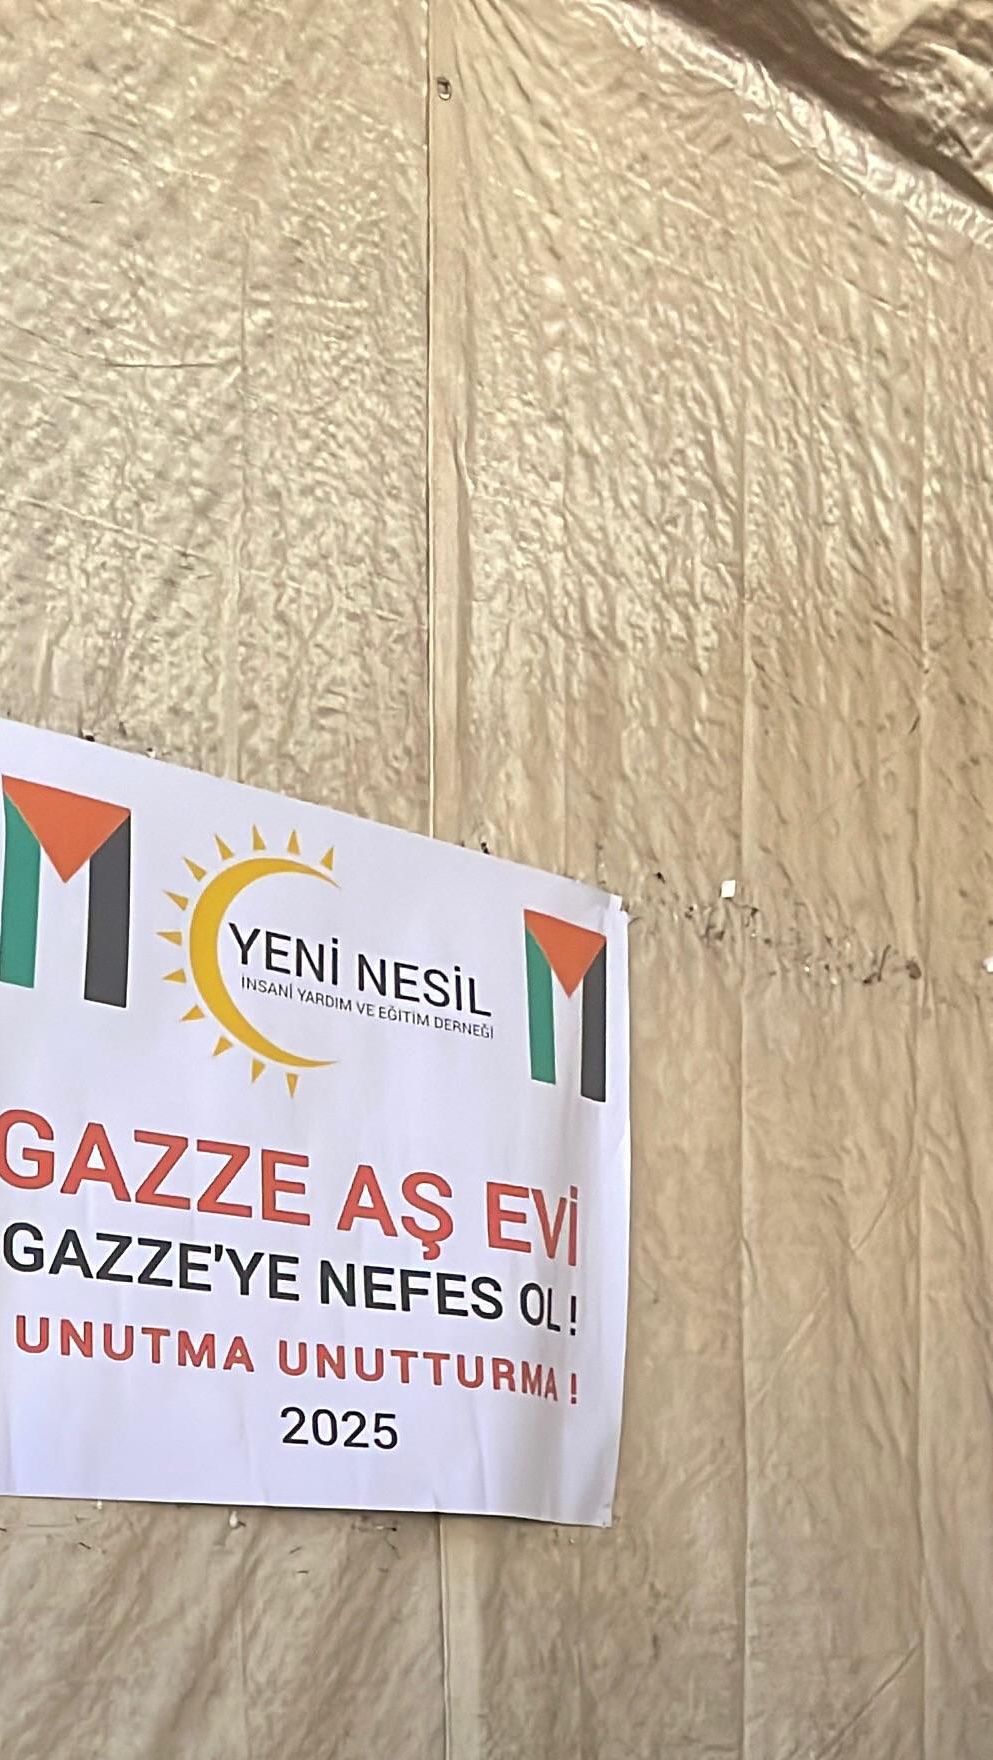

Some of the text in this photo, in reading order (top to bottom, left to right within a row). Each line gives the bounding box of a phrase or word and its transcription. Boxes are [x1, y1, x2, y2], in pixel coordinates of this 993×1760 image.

[229, 922, 493, 1018] YENİ NESİL
[297, 987, 353, 1013] YARDIM
[356, 1001, 375, 1017] VE
[337, 1164, 454, 1262] AŞ
[486, 1181, 578, 1267] EVİ
[3, 1221, 301, 1302] GAZZE'YE
[319, 1259, 504, 1321] NEFES
[520, 1282, 561, 1332] OL
[15, 1314, 578, 1405] UNUTMA UNUTTURMA !
[280, 1406, 399, 1450] 2025
